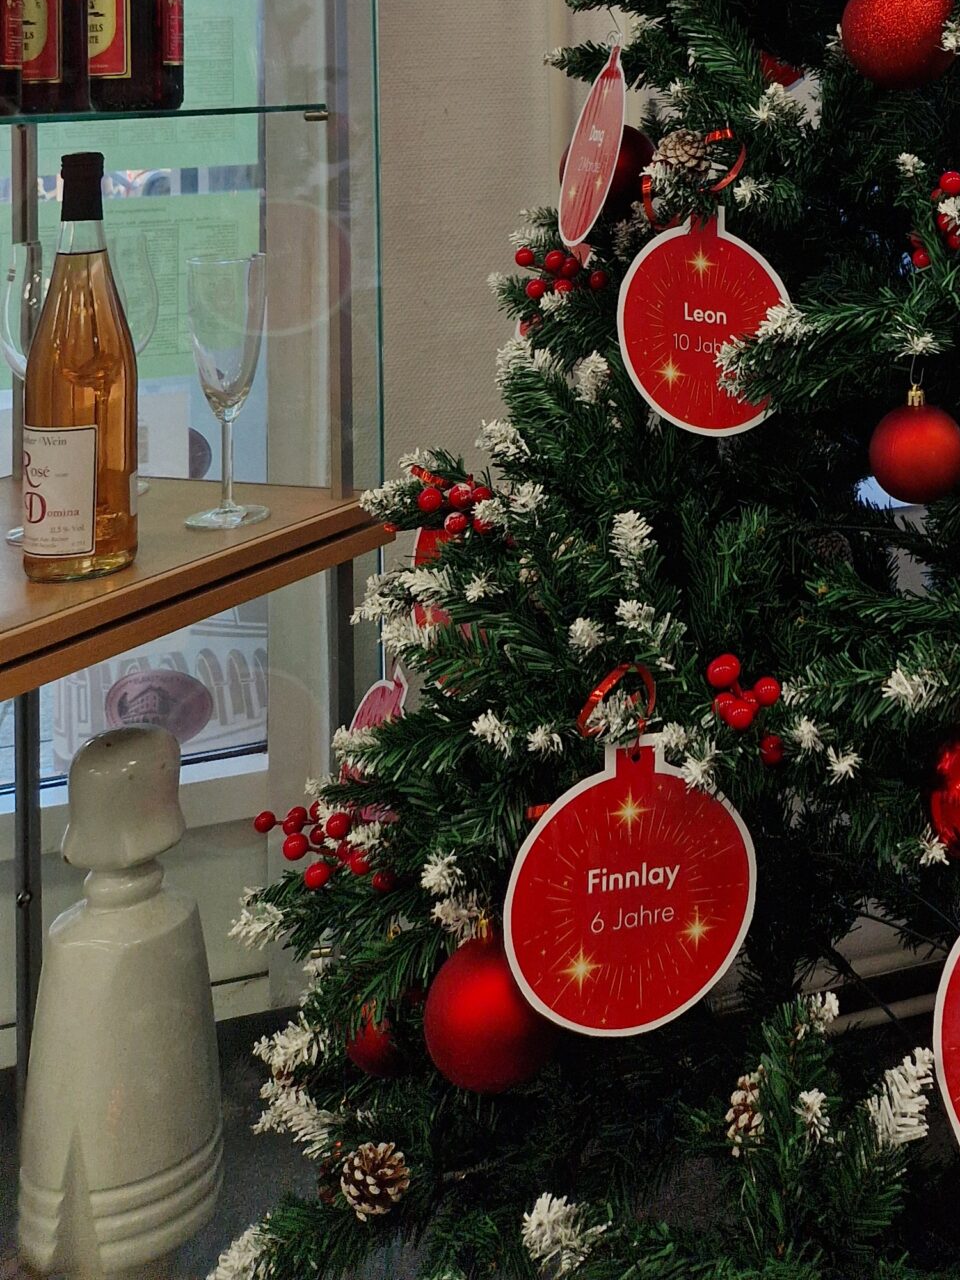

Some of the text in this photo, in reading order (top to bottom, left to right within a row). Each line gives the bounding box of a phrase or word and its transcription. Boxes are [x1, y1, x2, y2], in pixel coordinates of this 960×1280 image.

[683, 302, 727, 325] Leon
[672, 333, 723, 354] 10 Jah
[24, 491, 80, 524] Domina
[587, 862, 680, 894] Finnlay
[590, 905, 675, 934] 6 Jahre
